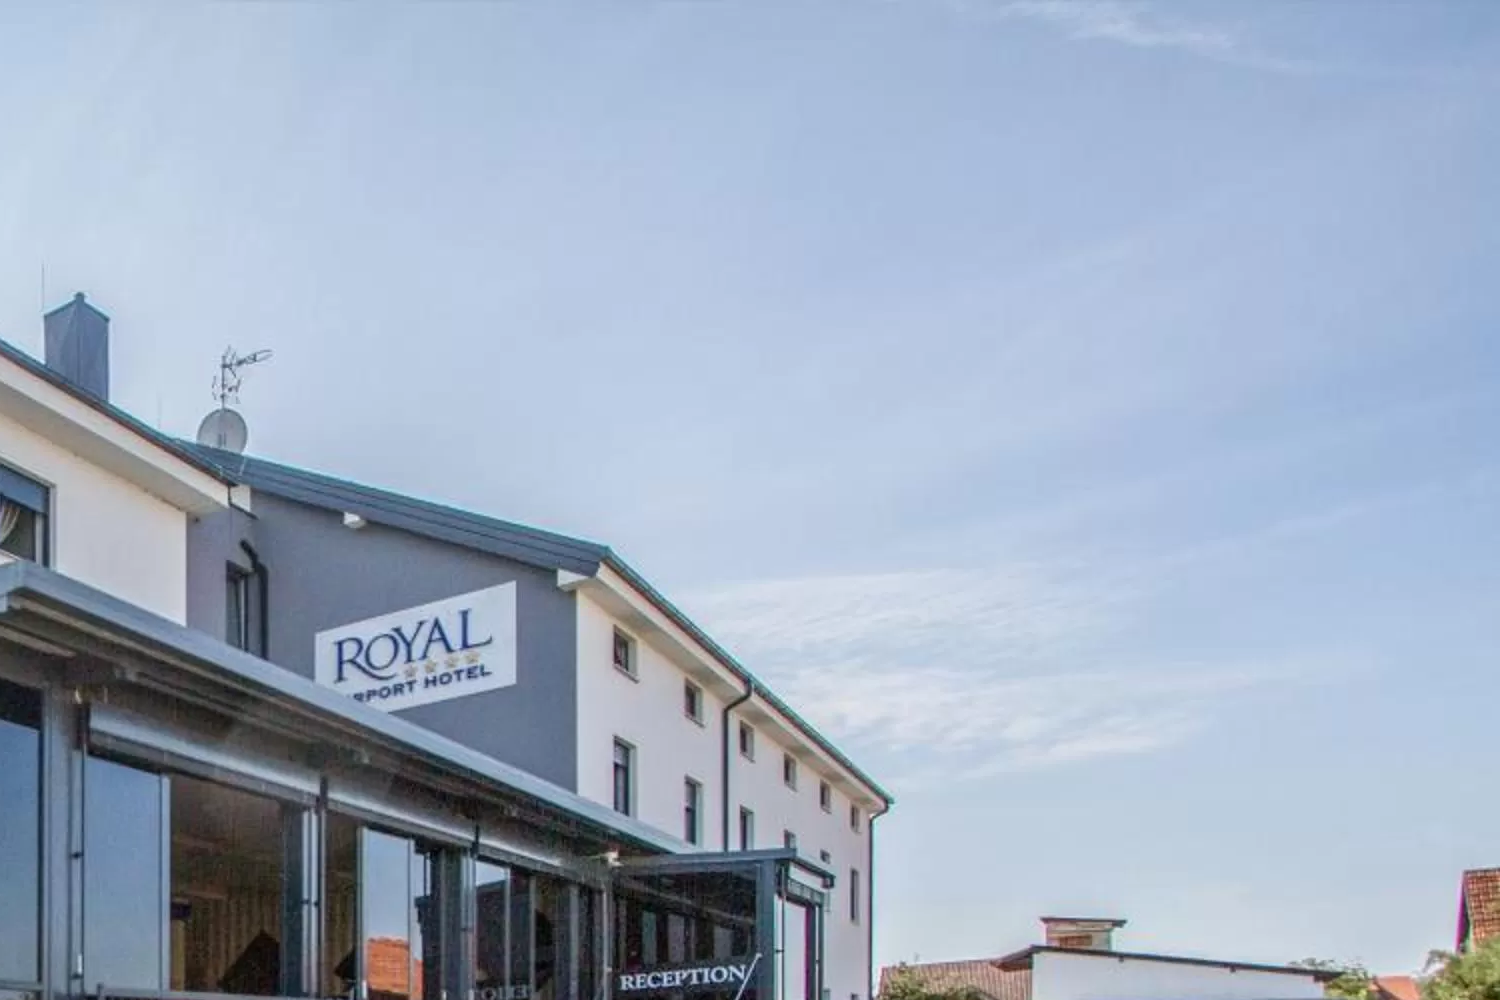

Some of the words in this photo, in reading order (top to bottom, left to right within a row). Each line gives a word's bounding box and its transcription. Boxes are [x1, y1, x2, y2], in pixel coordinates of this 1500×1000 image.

[333, 608, 493, 684] ROYAL
[423, 663, 493, 689] HOTEL
[619, 963, 747, 991] RECEPTION
